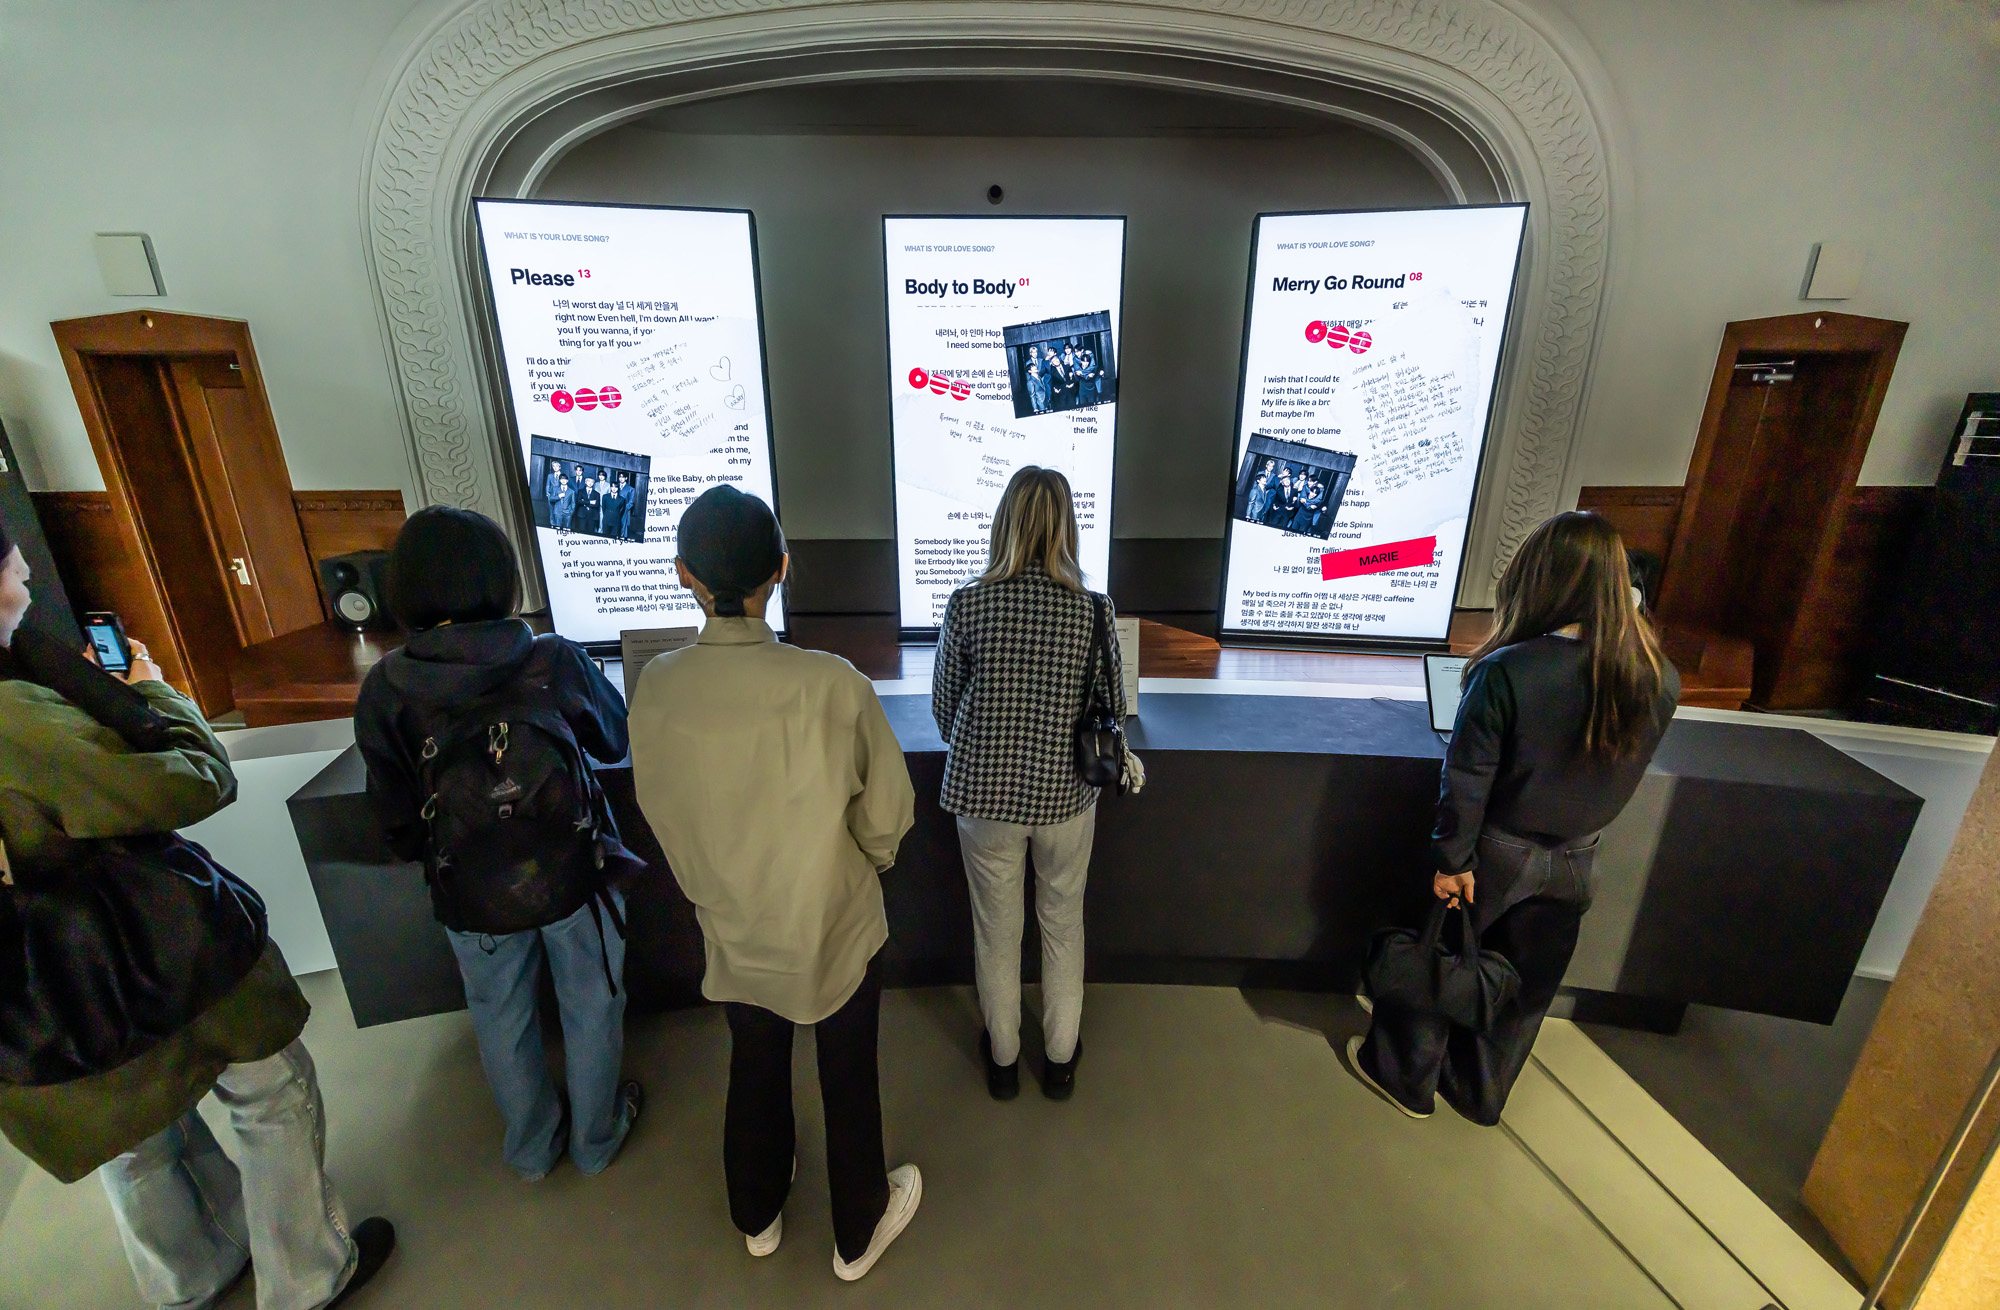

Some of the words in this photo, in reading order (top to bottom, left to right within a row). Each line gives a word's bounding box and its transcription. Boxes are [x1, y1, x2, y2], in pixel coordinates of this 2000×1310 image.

[510, 268, 575, 287] Please
[578, 269, 591, 278] 13
[905, 279, 948, 298] Body
[952, 280, 969, 295] to
[973, 279, 1016, 298] Body
[1019, 278, 1029, 286] 01
[1273, 277, 1320, 294] Merry
[1324, 276, 1348, 290] Go
[1352, 274, 1406, 290] Round
[1409, 272, 1423, 281] 08
[553, 300, 570, 309] 나의
[598, 301, 615, 311] day
[616, 301, 624, 311] 널
[626, 301, 635, 310] 더
[636, 301, 653, 311] 세게
[654, 302, 679, 311] 안을게
[555, 313, 576, 323] right
[597, 314, 620, 322] Even
[620, 314, 638, 324] hell,
[653, 315, 677, 323] down
[557, 328, 574, 336] you
[575, 326, 581, 334] If
[582, 328, 599, 336] you
[600, 328, 632, 336] wanna,
[960, 329, 968, 337] 야
[969, 329, 984, 338] 인마
[985, 329, 1001, 338] Hop
[559, 339, 582, 349] thing
[583, 338, 595, 347] for
[597, 341, 608, 349] ya
[609, 339, 614, 347] If
[616, 341, 632, 349] you
[536, 357, 549, 366] do
[533, 394, 550, 403] 오직
[1262, 399, 1274, 408] My
[1275, 410, 1302, 420] maybe
[1273, 427, 1290, 435] only
[682, 475, 705, 484] Baby,
[718, 474, 743, 483] please
[947, 512, 961, 520] 손에
[962, 512, 969, 520] 손
[914, 538, 952, 547] Somebody
[914, 548, 952, 557] Somebody
[928, 558, 956, 567] Errbody
[1359, 550, 1399, 566] MARIE
[570, 571, 591, 579] thing
[929, 568, 967, 577] Somebody
[916, 578, 953, 586] Somebody
[1390, 579, 1412, 588] 침대는
[1413, 580, 1429, 588] 나의
[1430, 581, 1438, 589] 관
[1243, 590, 1255, 598] My
[1338, 593, 1360, 601] 세상은
[1361, 594, 1383, 602] 거대한
[1383, 595, 1415, 603] caffeine
[609, 606, 635, 614] please
[636, 604, 658, 612] 세상이
